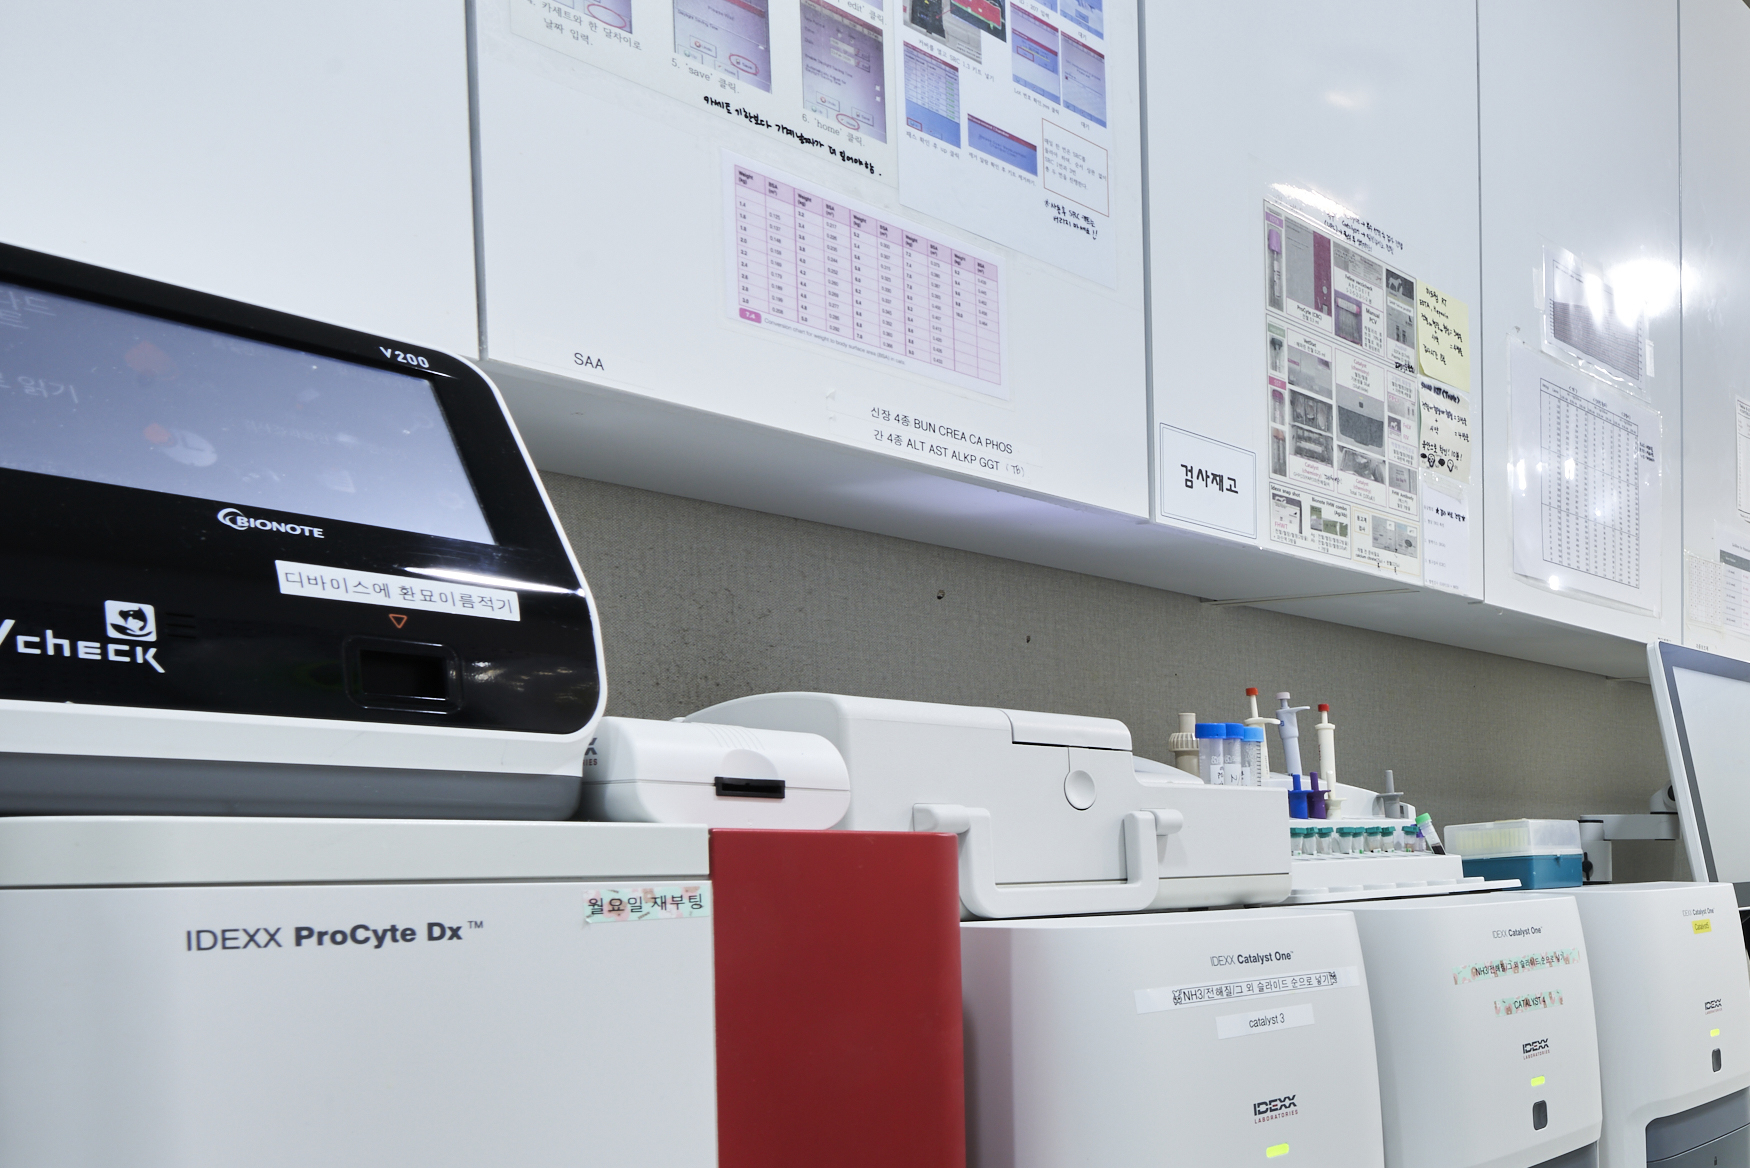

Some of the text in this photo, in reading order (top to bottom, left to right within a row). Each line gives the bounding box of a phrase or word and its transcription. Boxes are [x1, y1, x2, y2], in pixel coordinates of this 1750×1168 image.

[540, 0, 642, 52] 카세트와 한 달차이로
[544, 17, 594, 46] 날짜 입력.
[671, 58, 681, 70] 5.
[718, 76, 740, 94] 클릭.
[802, 113, 810, 124] 6.
[846, 129, 866, 147] 클릭.
[380, 346, 430, 368] V200
[573, 352, 605, 372] SAA
[870, 406, 1014, 455] 신장 4종 BUN CREA CA PHOS
[873, 429, 884, 442] 간
[886, 432, 903, 447] 4종
[906, 438, 926, 452] ALT
[928, 443, 949, 458] AST
[951, 450, 977, 465] ALKP
[979, 457, 1000, 471] GGT
[1180, 463, 1239, 496] 검사재고
[235, 512, 325, 539] BIONOTE
[283, 567, 514, 616] 디바이스에 환묘이름적기
[586, 892, 704, 916] 월요일 재부팅
[1692, 908, 1707, 916] Catalyst
[186, 926, 282, 952] IDEXX
[294, 924, 417, 949] ProCyte
[1492, 930, 1508, 939] IDEXX
[1508, 927, 1531, 937] Catalyst
[1210, 955, 1236, 967] IDEXX
[1236, 951, 1274, 965] Catalyst
[1182, 974, 1330, 1002] NH3/전해질/그 외 슬라이드 순으로 넣기
[1513, 996, 1541, 1010] CATALYST
[1704, 998, 1722, 1011] IDEXX
[1248, 1012, 1286, 1028] catalyst 3
[1522, 1038, 1550, 1054] IDEXX
[1253, 1094, 1297, 1116] IDEXX
[1254, 1110, 1299, 1124] LABORATORIES
